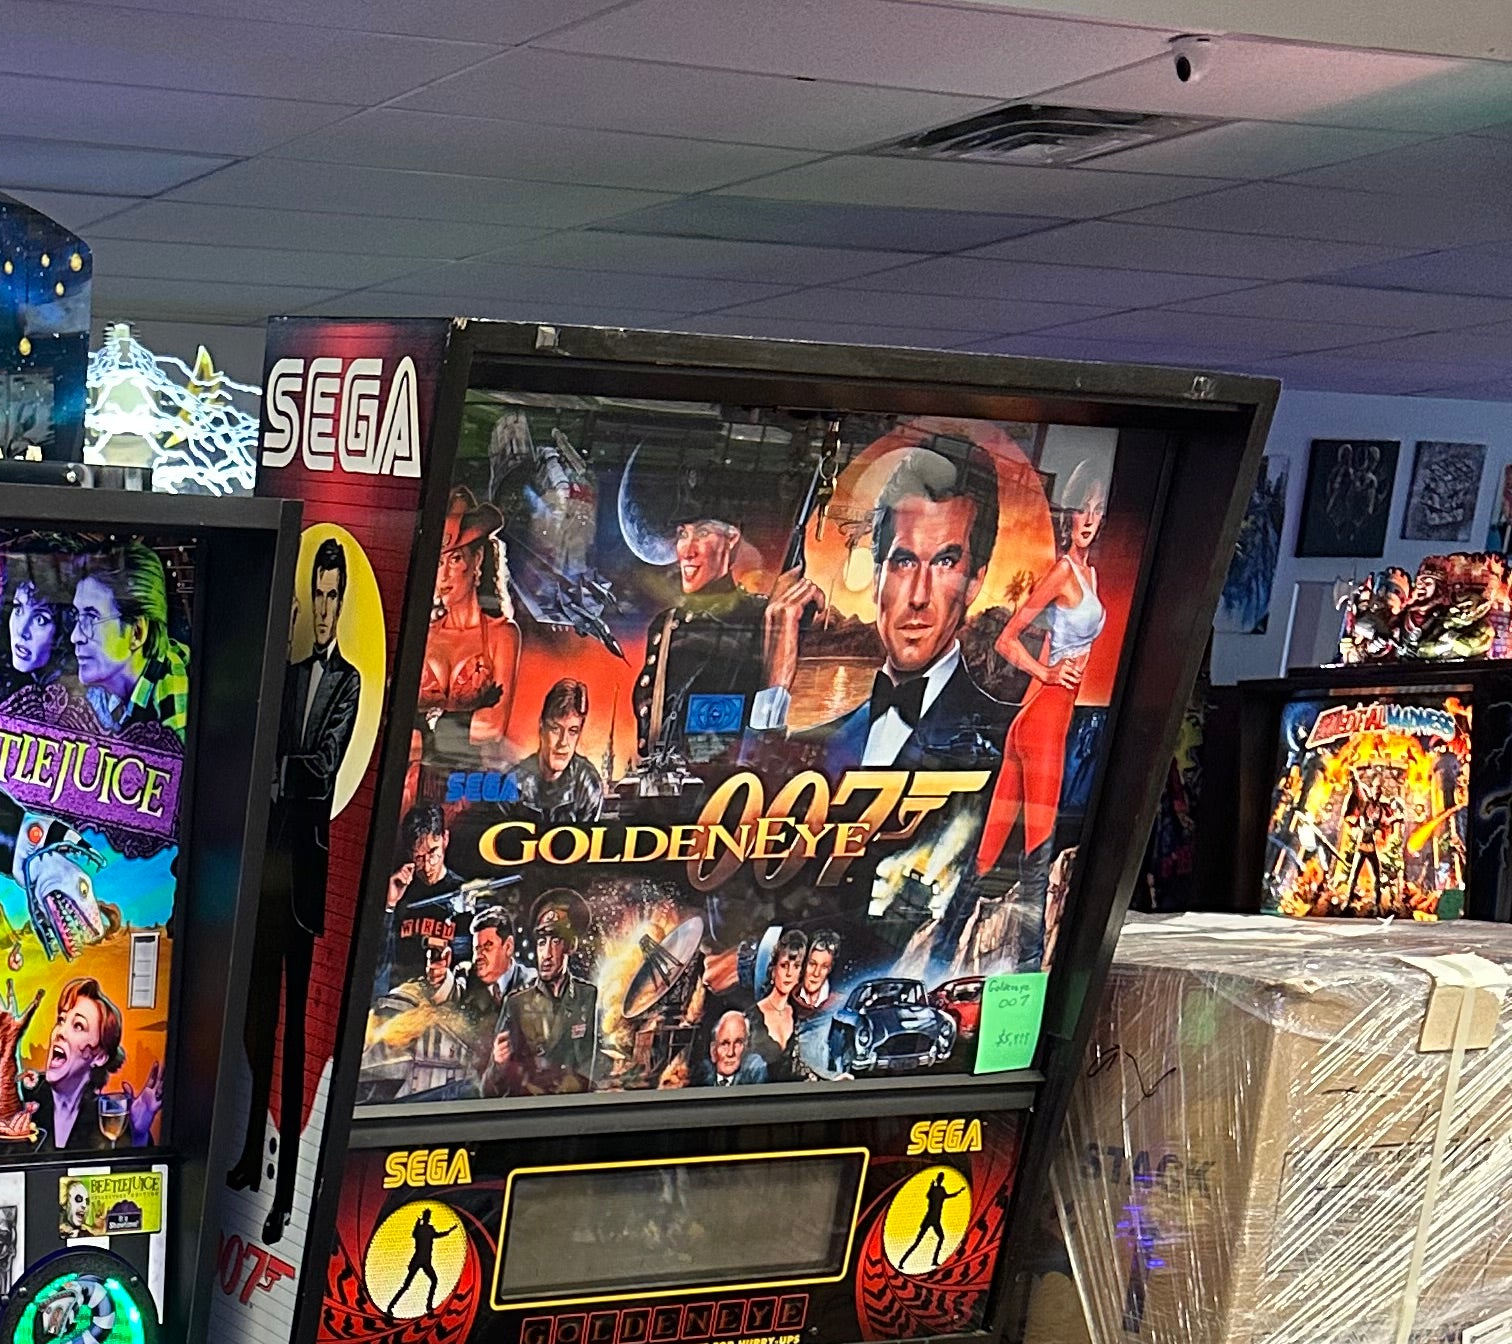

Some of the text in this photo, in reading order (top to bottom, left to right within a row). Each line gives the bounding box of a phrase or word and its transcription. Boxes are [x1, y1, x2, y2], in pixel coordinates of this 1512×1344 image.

[262, 356, 421, 478] SEGA
[445, 771, 520, 802] SEGA
[400, 916, 456, 940] WIRED
[998, 994, 1031, 1009] 007
[905, 1118, 982, 1155] SEGA
[90, 1176, 160, 1194] BEETLEJUICE
[383, 1149, 472, 1190] SEGA
